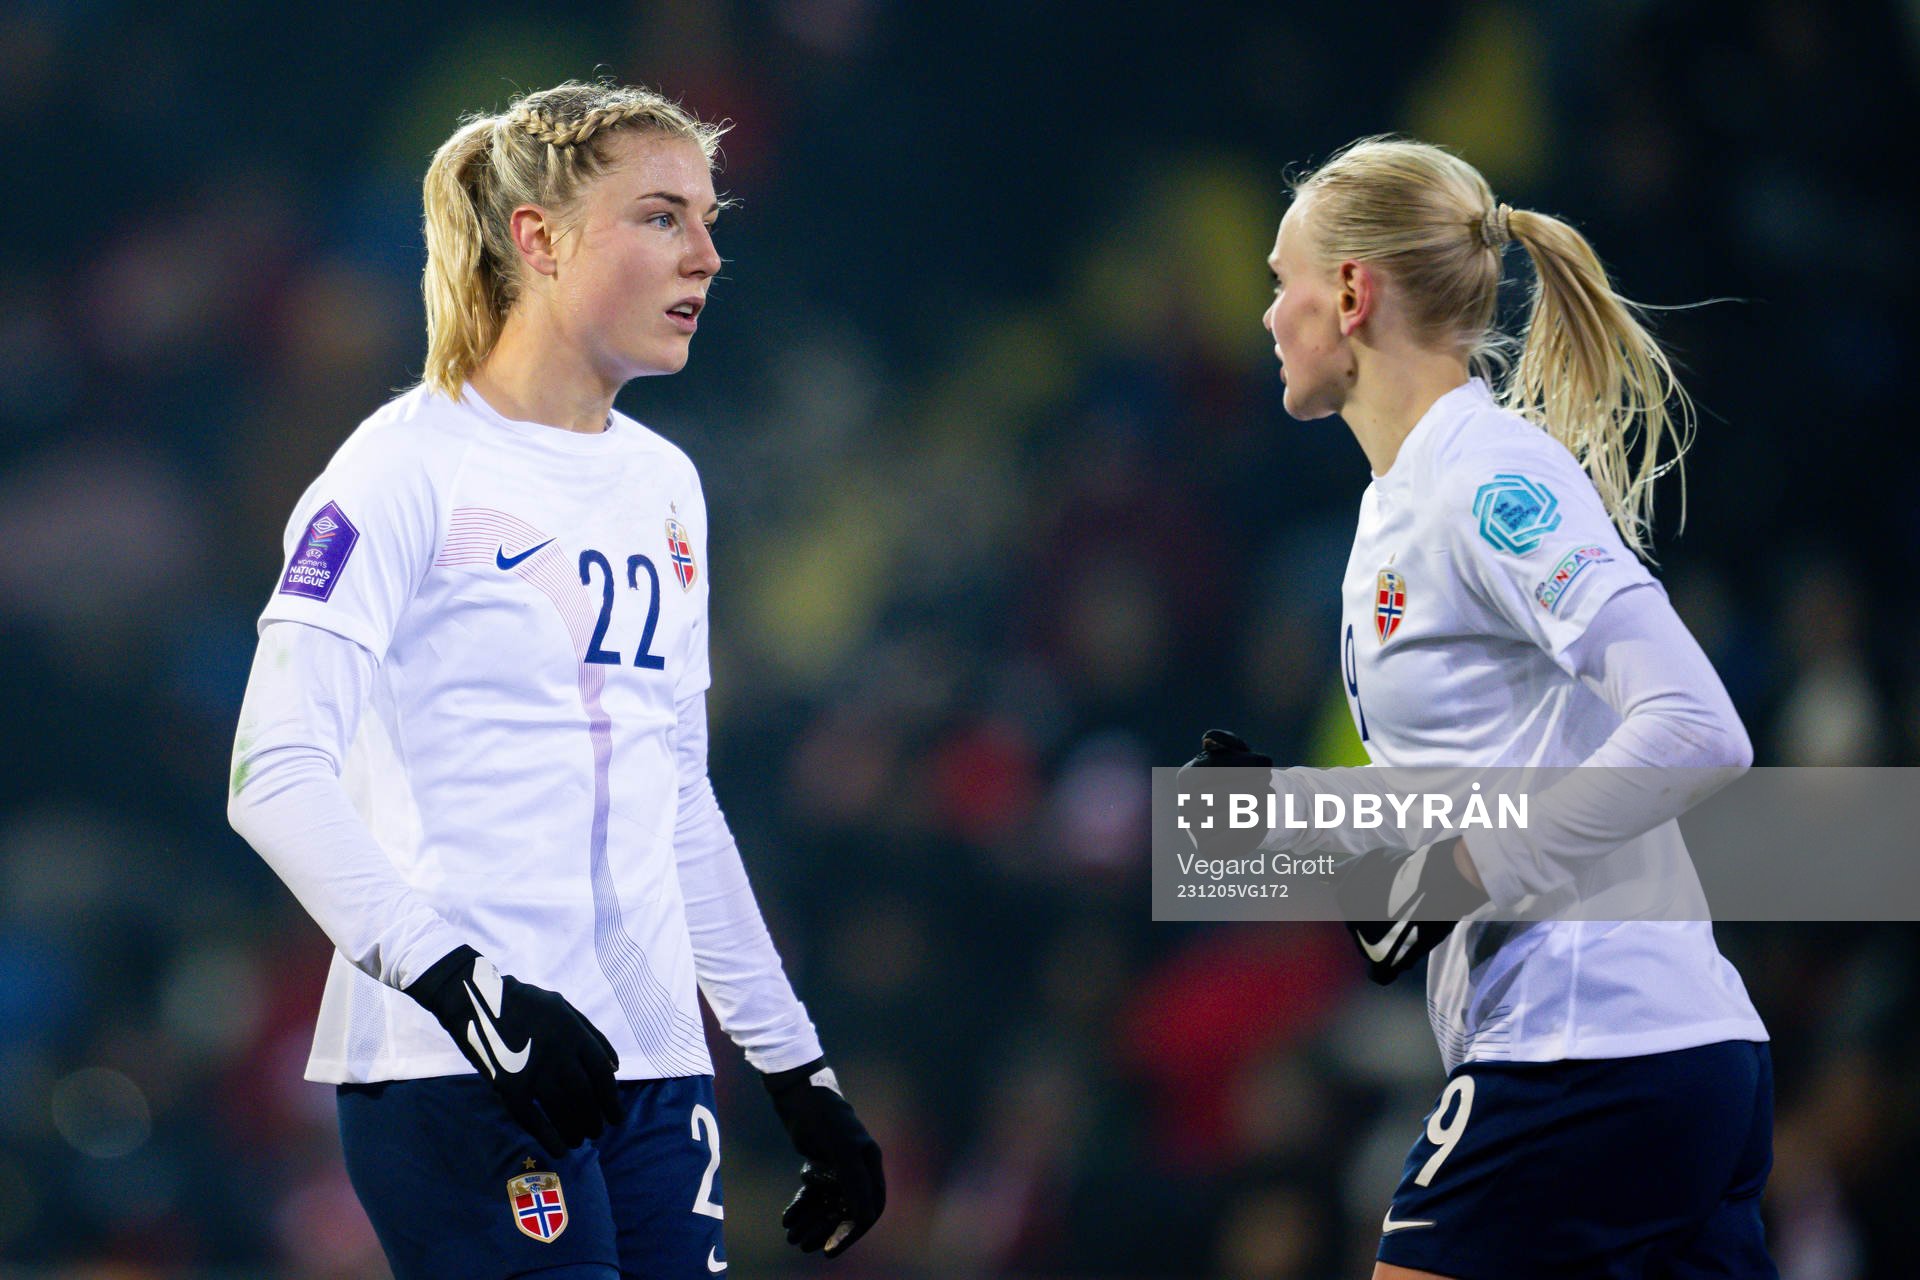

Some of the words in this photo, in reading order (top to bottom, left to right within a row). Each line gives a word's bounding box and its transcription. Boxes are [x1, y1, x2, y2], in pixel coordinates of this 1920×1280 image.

[288, 574, 326, 588] LEAGUE
[289, 565, 331, 580] NATIONS
[579, 549, 665, 670] 22
[1346, 624, 1369, 741] 9
[691, 1103, 724, 1221] 2
[1414, 1075, 1476, 1188] 9
